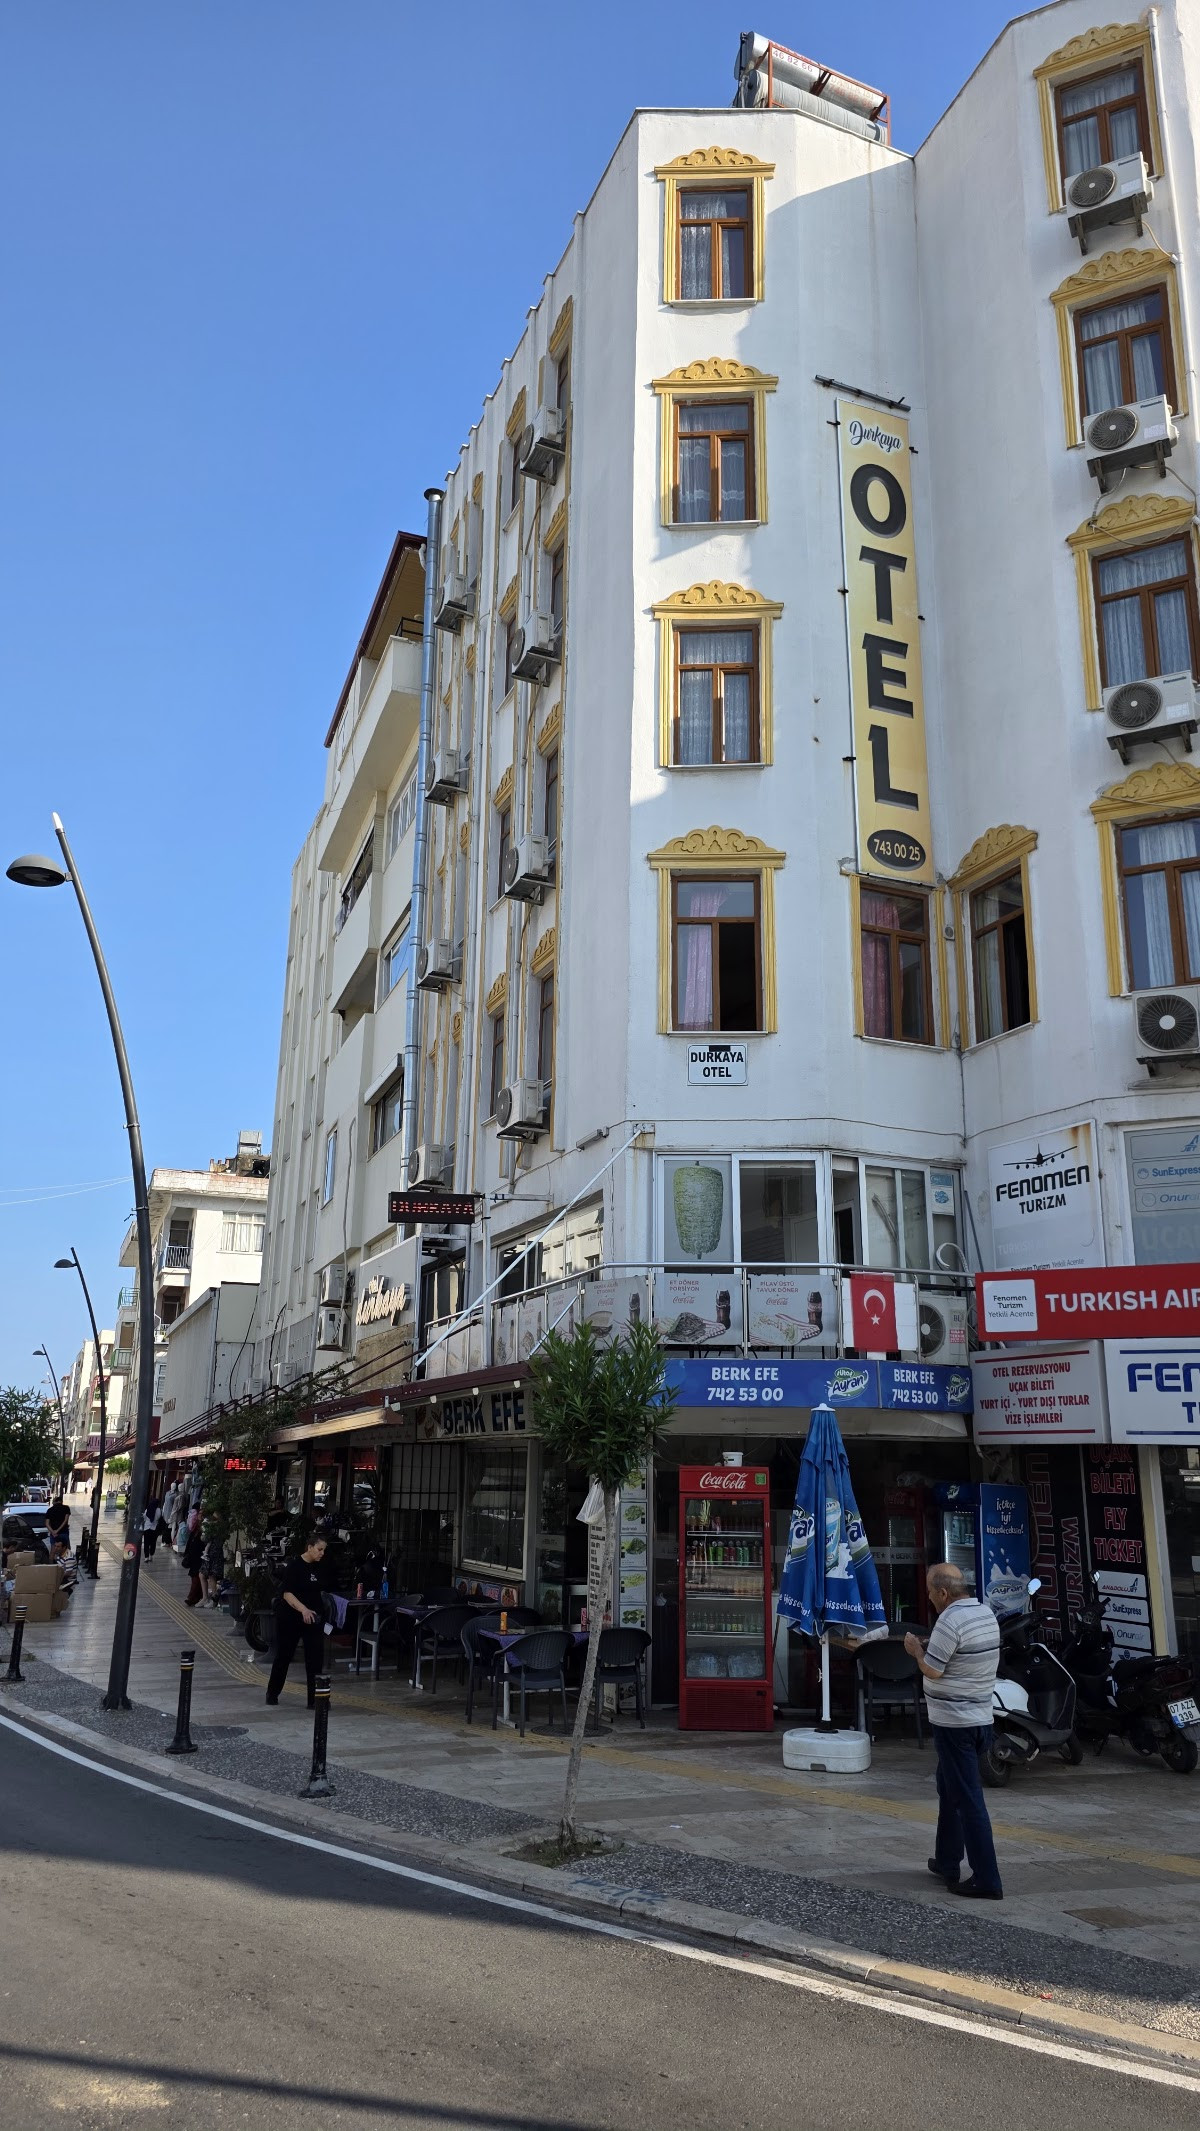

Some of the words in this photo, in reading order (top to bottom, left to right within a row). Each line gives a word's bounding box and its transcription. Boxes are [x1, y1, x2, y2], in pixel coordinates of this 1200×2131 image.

[849, 421, 902, 453] Durkaya
[850, 463, 919, 811] OTEL
[873, 838, 892, 856] 743
[894, 842, 907, 859] 00
[909, 845, 920, 861] 25
[690, 1051, 744, 1063] DURKAYA
[702, 1066, 732, 1078] OTEL
[996, 1164, 1091, 1202] FENOMEN
[1066, 1257, 1085, 1266] Acente
[1045, 1289, 1157, 1313] TURKISH
[988, 1311, 1008, 1319] Yetkili
[711, 1367, 751, 1381] BERK
[754, 1367, 779, 1381] EFE
[893, 1368, 918, 1384] BERK
[920, 1371, 935, 1385] EFE
[992, 1367, 1010, 1378] OTEL
[1011, 1362, 1071, 1377] REZERVASYONU
[832, 1375, 864, 1394] Ayran
[1009, 1381, 1029, 1395] UÇAK
[1030, 1377, 1055, 1391] BİLETİ
[707, 1387, 735, 1401] 742
[738, 1387, 758, 1401] 53
[764, 1387, 784, 1401] 00
[892, 1388, 910, 1403] 742
[911, 1390, 924, 1404] 53
[925, 1391, 939, 1405] 00
[980, 1399, 999, 1410] YURT
[1000, 1395, 1011, 1411] İÇİ
[1017, 1397, 1037, 1408] YURT
[1040, 1396, 1056, 1410] DIŞI
[1058, 1394, 1090, 1406] TURLAR
[443, 1396, 486, 1435] BERK
[491, 1390, 526, 1432] EFE
[1005, 1411, 1022, 1424] VİZE
[1023, 1409, 1063, 1427] İŞLEMLERİ
[1181, 1401, 1200, 1423] T
[700, 1471, 749, 1490] Coca-Cola
[1090, 1466, 1136, 1495] BİLETİ
[1103, 1506, 1128, 1531] FLY
[1093, 1537, 1143, 1564] TICKET
[1112, 1603, 1142, 1616] SunExpress
[1169, 1703, 1179, 1714] 07
[1180, 1699, 1196, 1710] AZZ
[1178, 1710, 1194, 1721] 338
